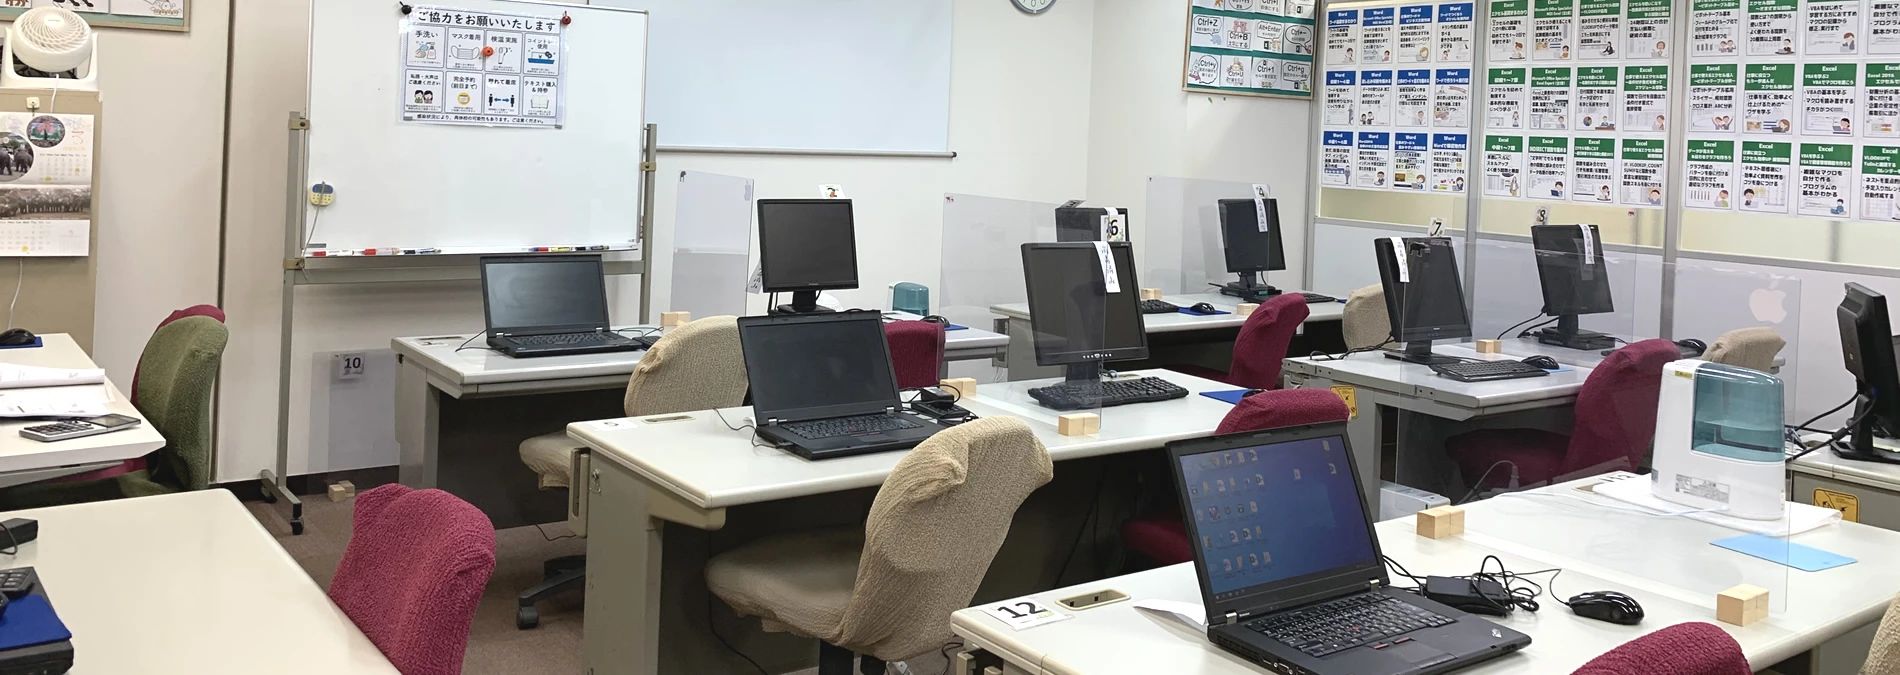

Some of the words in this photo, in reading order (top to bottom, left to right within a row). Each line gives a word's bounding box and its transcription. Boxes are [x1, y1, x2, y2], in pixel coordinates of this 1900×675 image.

[418, 11, 556, 32] ご協力をお願いいたします
[1198, 18, 1218, 27] Ctrl+Z
[1259, 24, 1281, 32] Alt+Enter
[416, 31, 439, 39] 手洗い
[452, 33, 481, 41] マスク着用
[1229, 31, 1248, 41] Ctrl+B
[1288, 65, 1305, 74] Ctrl+g
[1110, 219, 1119, 236] 6
[344, 357, 362, 369] 10
[997, 601, 1049, 619] 12
